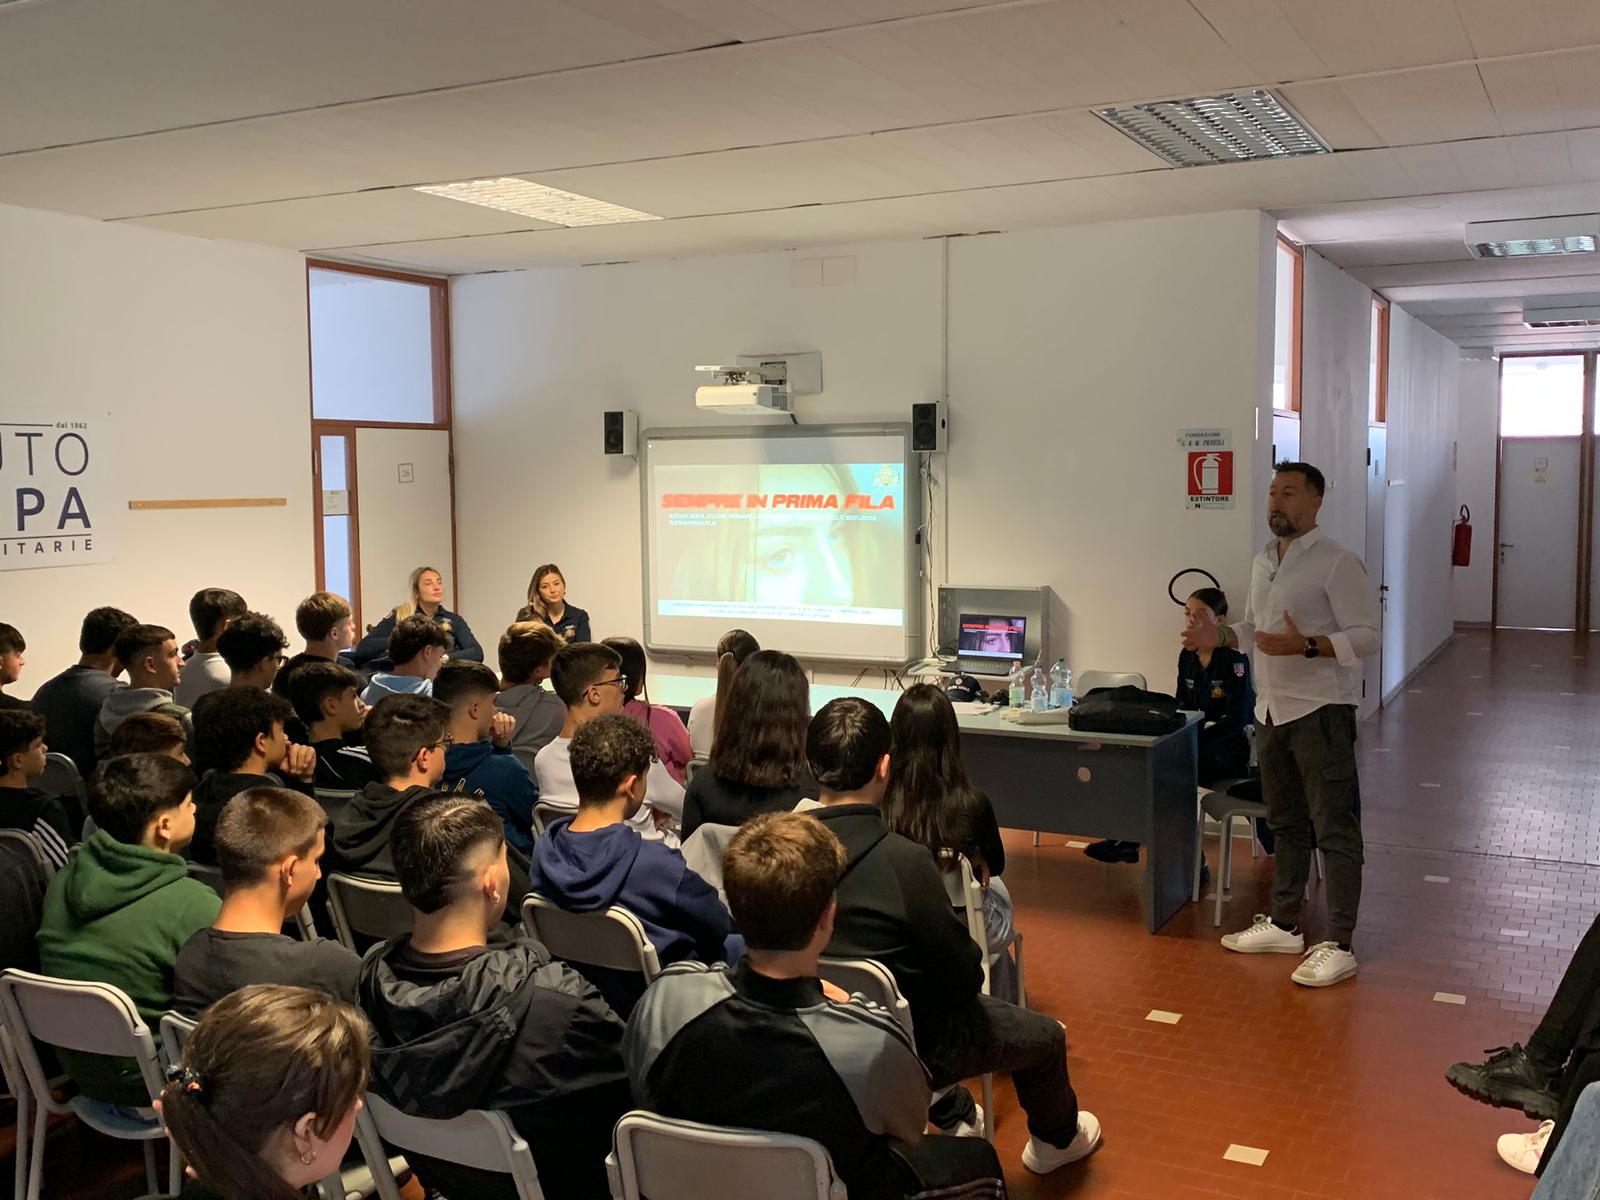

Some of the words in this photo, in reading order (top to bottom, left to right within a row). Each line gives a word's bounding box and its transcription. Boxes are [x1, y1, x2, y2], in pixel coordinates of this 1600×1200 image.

[70, 422, 88, 430] 1962
[0, 432, 89, 476] TO
[16, 486, 92, 531] PA
[661, 493, 744, 509] SEMPRE
[746, 493, 769, 509] IN
[771, 493, 839, 510] PRIMA
[844, 493, 896, 511] FILA
